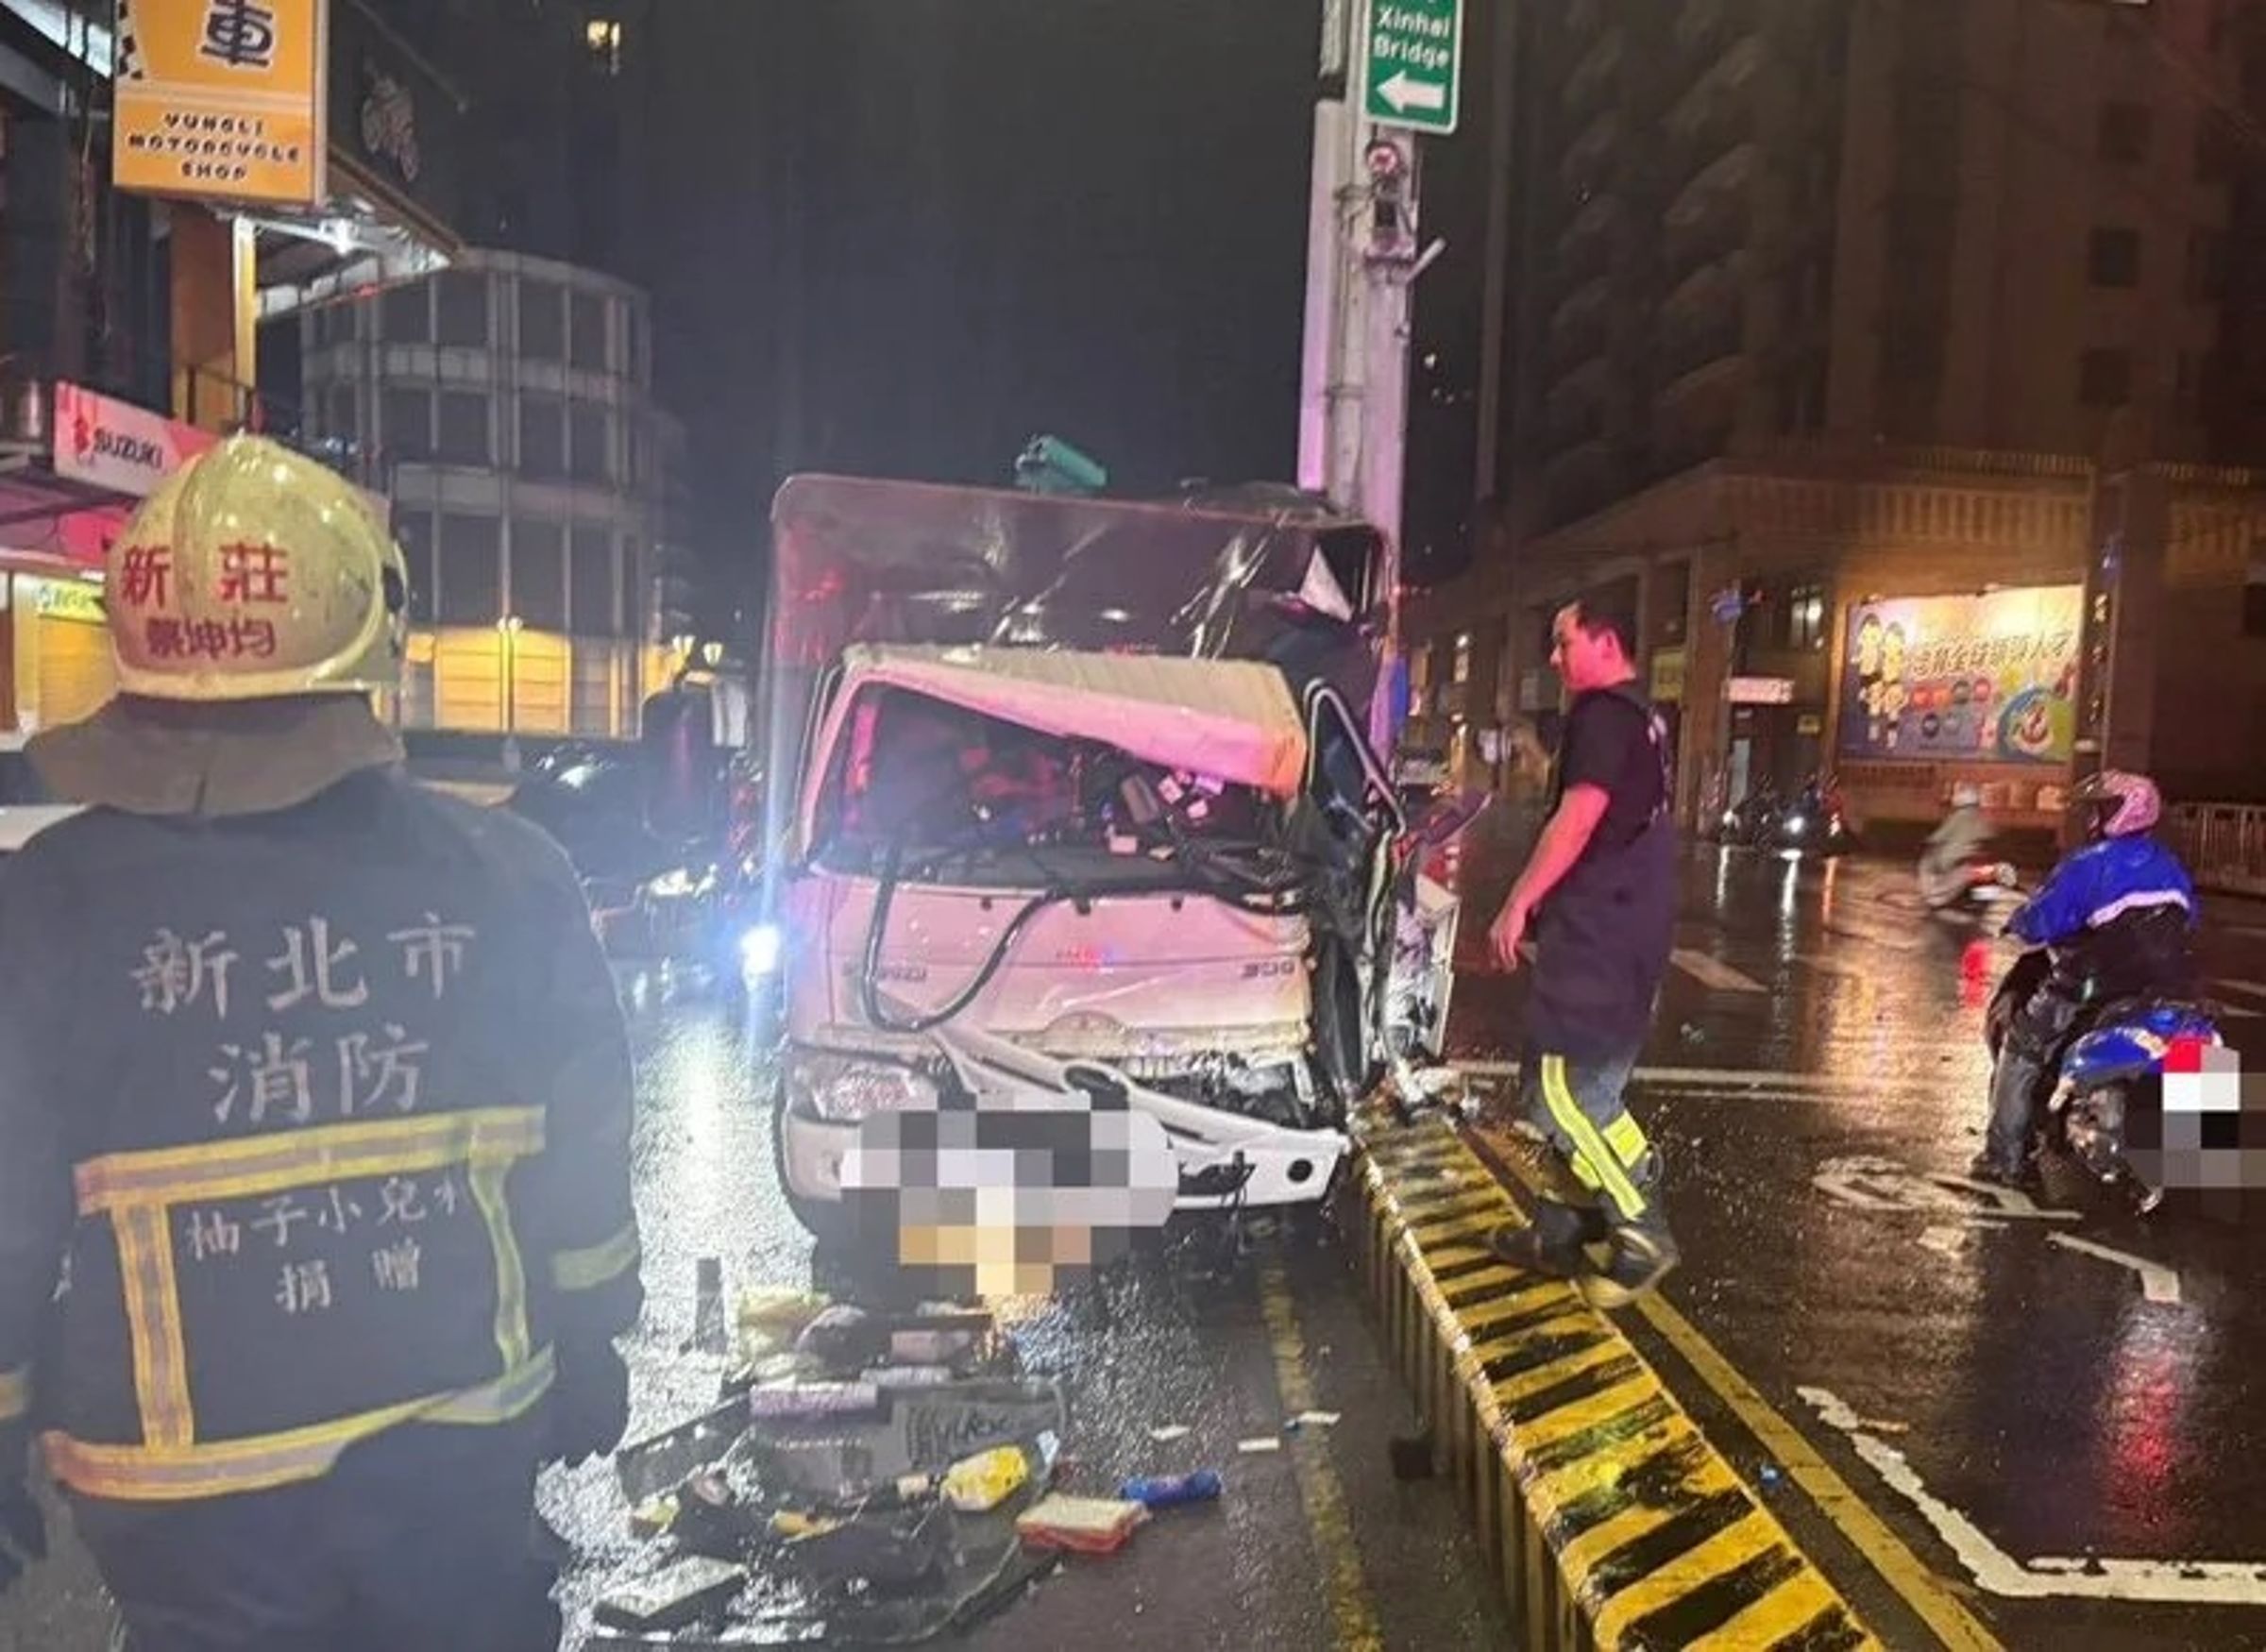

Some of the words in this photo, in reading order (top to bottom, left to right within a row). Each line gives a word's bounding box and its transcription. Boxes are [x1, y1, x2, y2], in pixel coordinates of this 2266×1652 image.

[200, 0, 273, 67] 車
[1378, 6, 1451, 37] Xinhai
[1374, 34, 1449, 70] Bridge
[128, 134, 300, 161] MOTORCYCLE
[181, 161, 247, 181] SHOP
[94, 427, 164, 469] SUZUKI
[122, 542, 287, 607] 新莊
[129, 912, 476, 1020] 新北市
[209, 1022, 431, 1124] 消防
